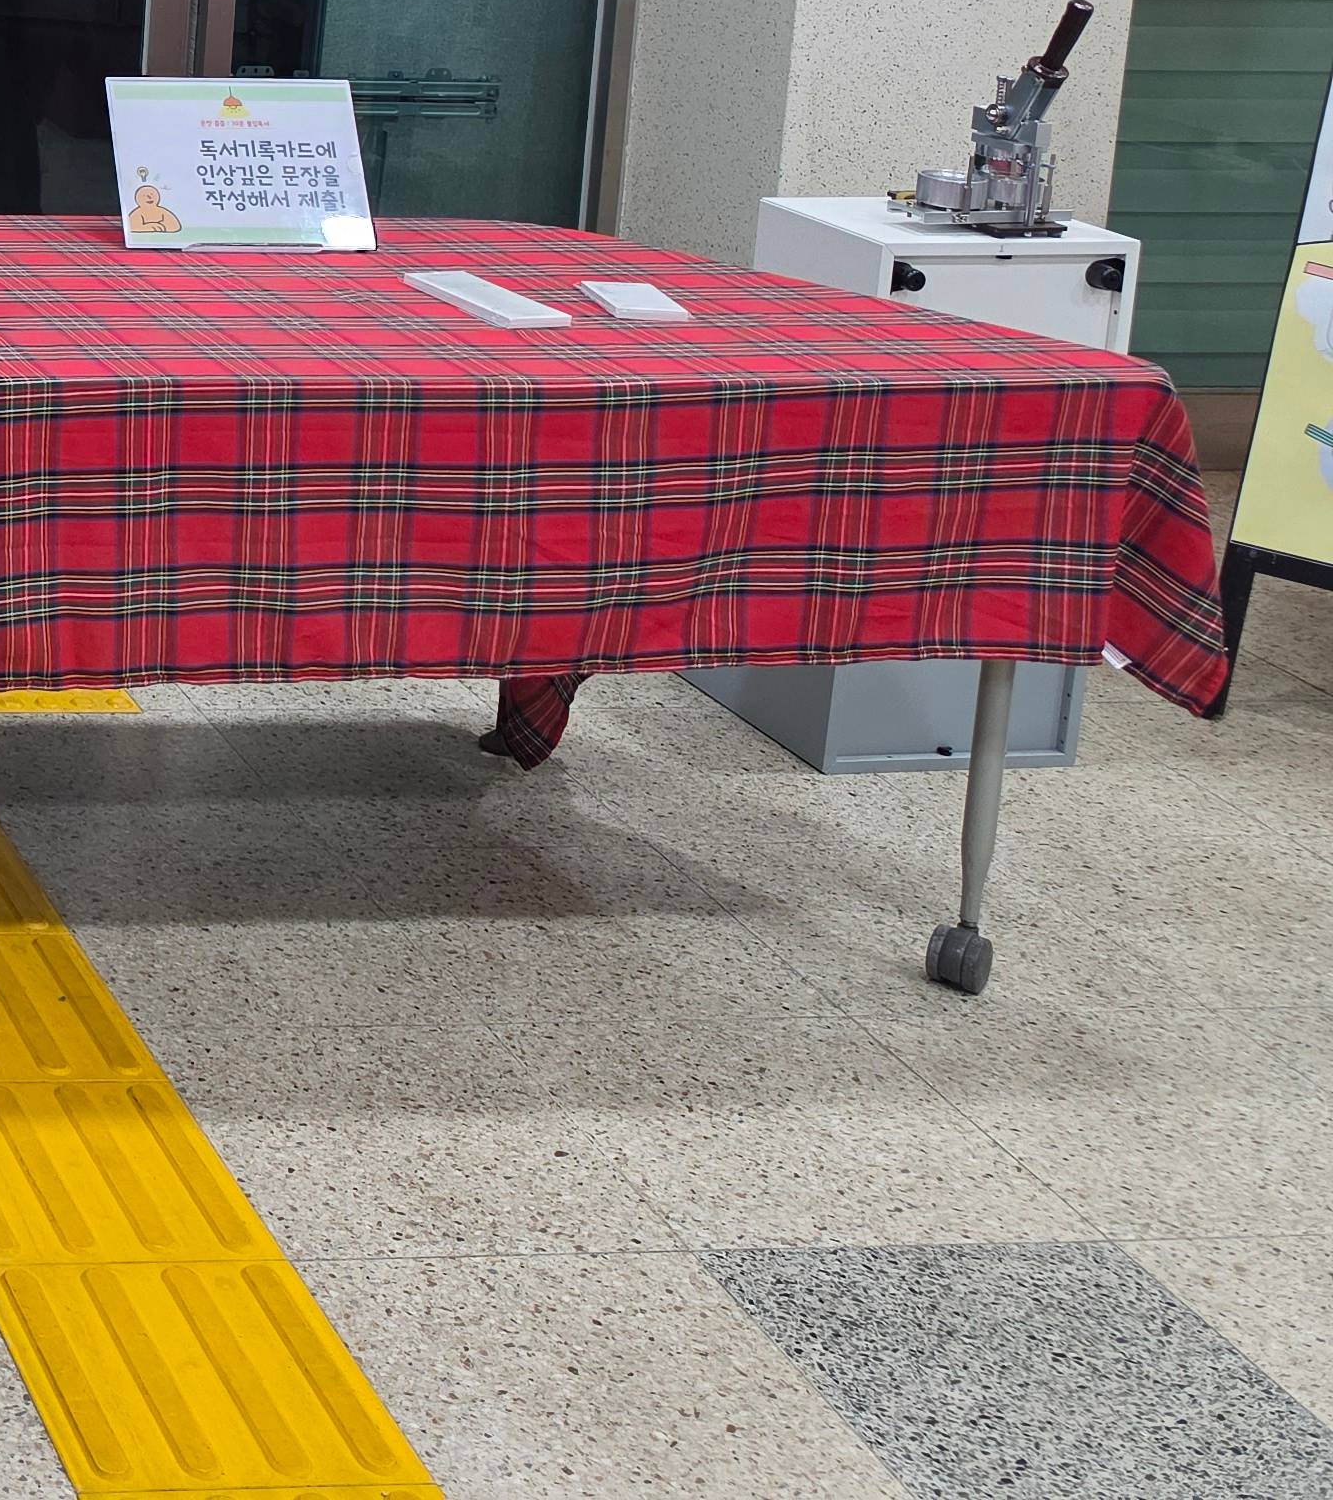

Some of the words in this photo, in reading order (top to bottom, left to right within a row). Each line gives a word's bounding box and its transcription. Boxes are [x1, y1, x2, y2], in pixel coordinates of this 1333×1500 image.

[200, 140, 337, 160] 독서기록카드에
[197, 164, 273, 186] 인상깊은
[282, 165, 339, 187] 문장을
[205, 190, 290, 211] 작성해서
[298, 190, 346, 212] 제출!
